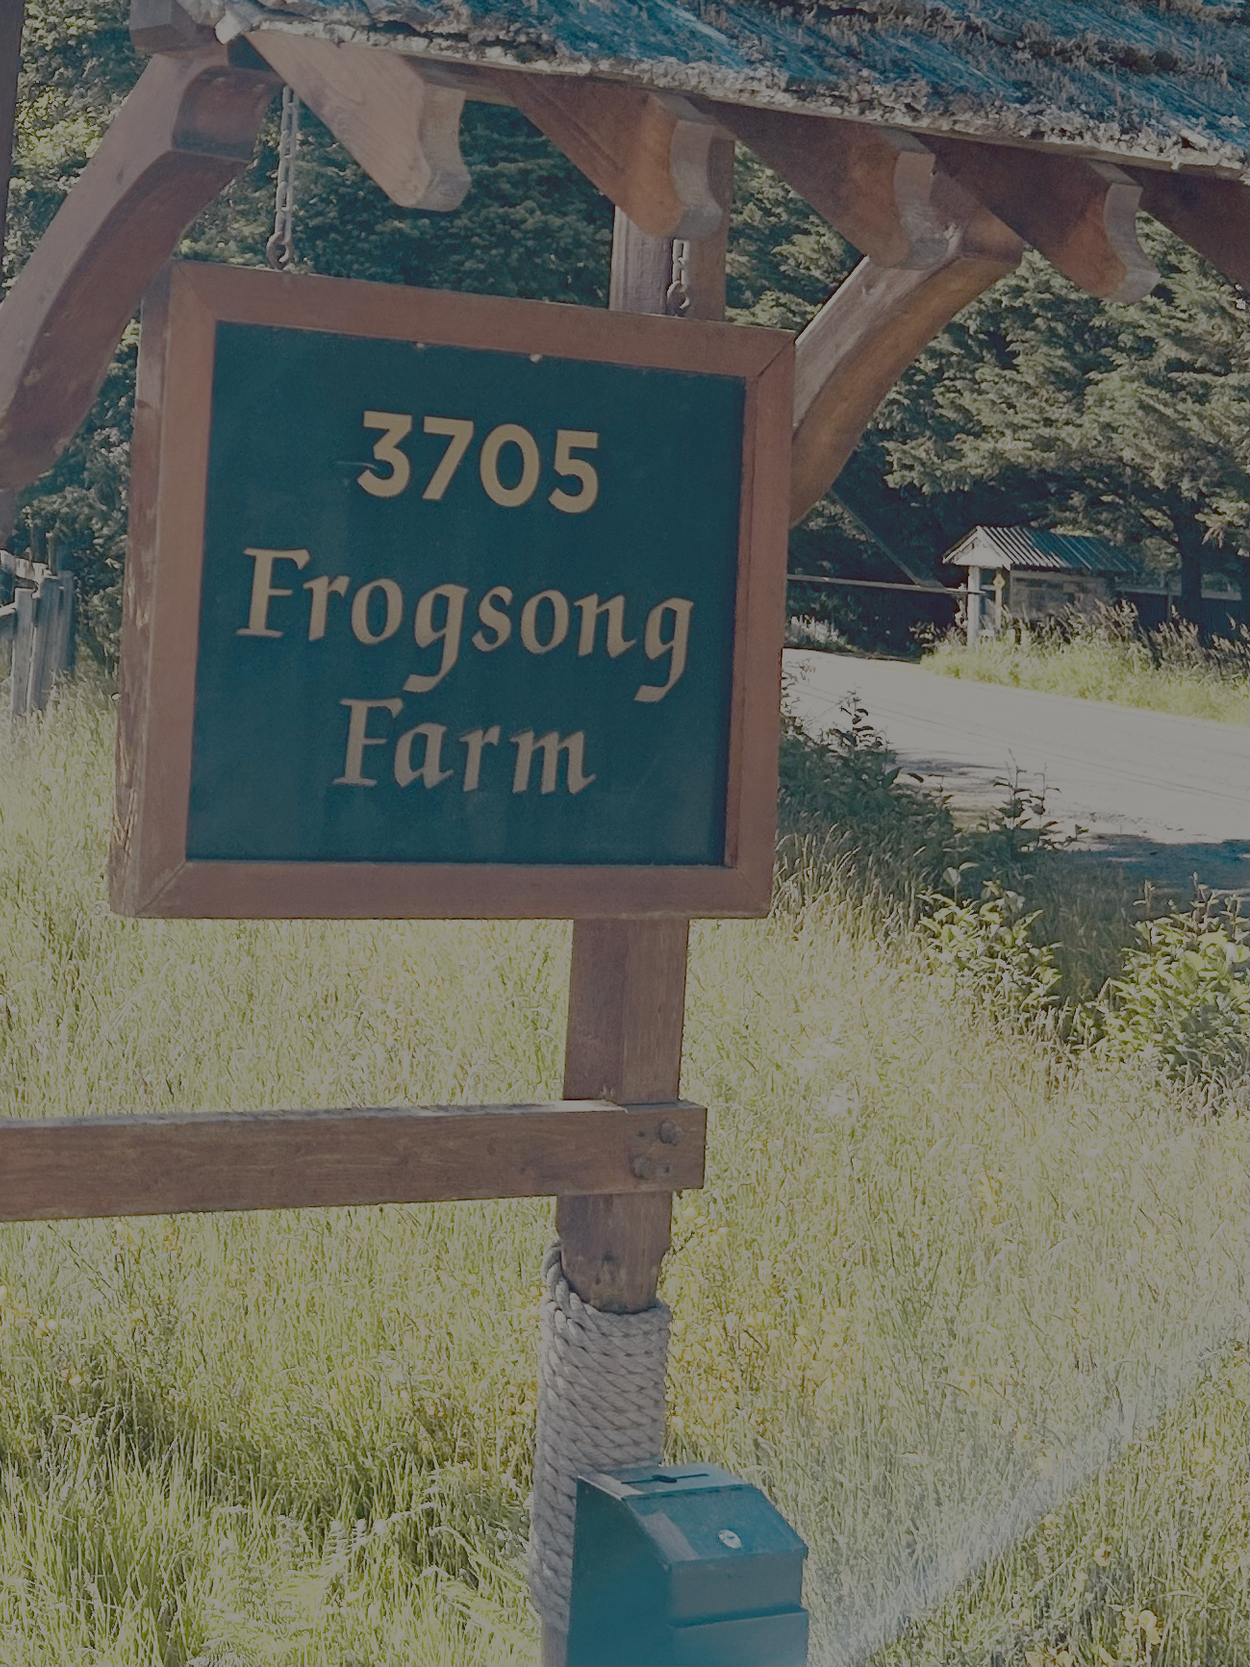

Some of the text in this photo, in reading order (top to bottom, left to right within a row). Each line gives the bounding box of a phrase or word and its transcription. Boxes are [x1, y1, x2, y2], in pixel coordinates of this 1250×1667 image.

[357, 410, 601, 513] 3705
[236, 547, 695, 702] Frogsong
[333, 698, 597, 795] Farm
